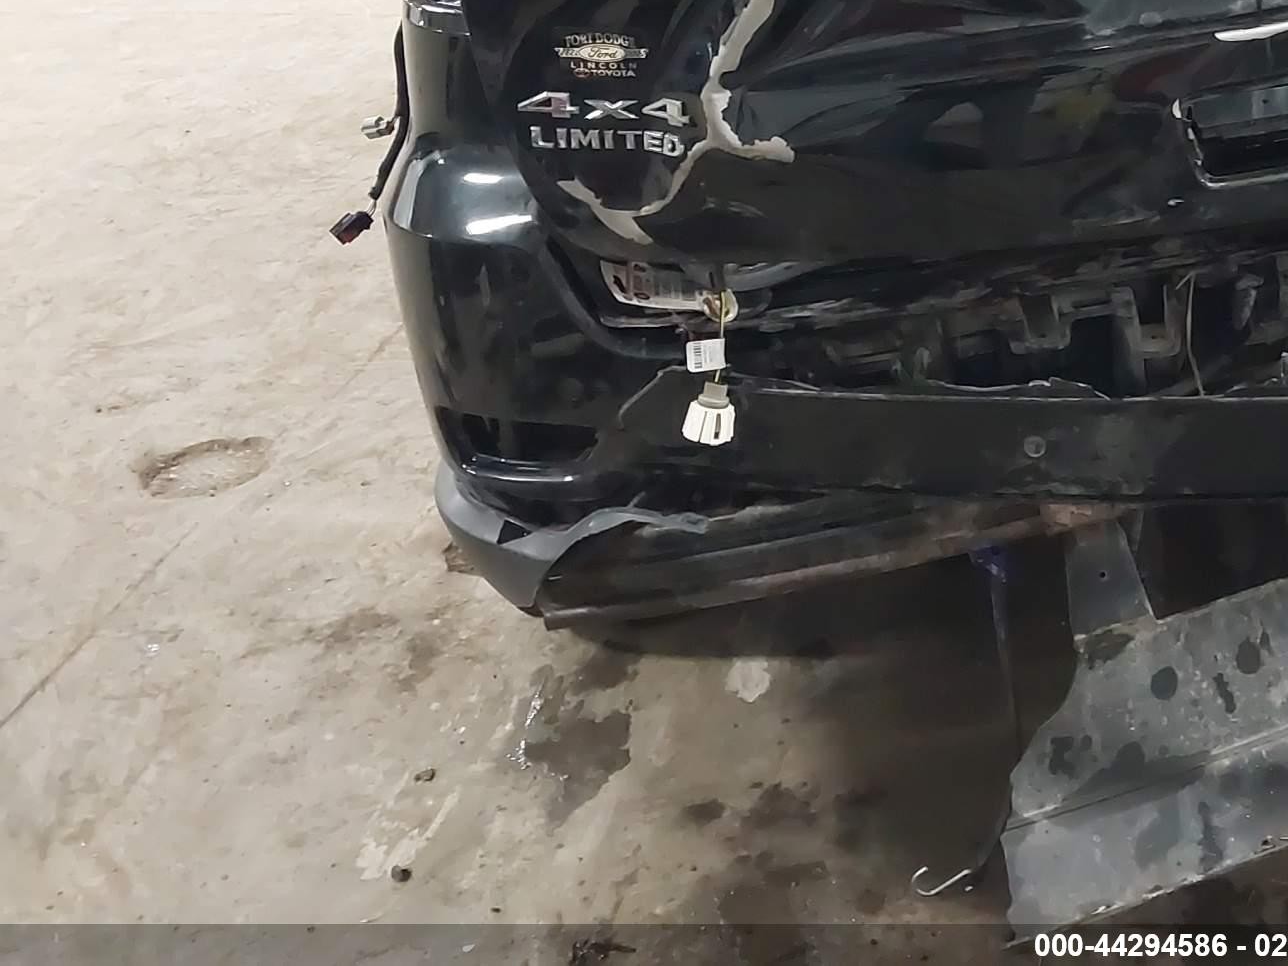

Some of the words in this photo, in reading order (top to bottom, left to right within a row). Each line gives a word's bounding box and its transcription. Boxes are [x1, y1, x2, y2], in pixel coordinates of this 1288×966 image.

[570, 61, 637, 69] LINCOLN
[591, 69, 637, 77] TOYOTA
[529, 126, 685, 157] LIMITED
